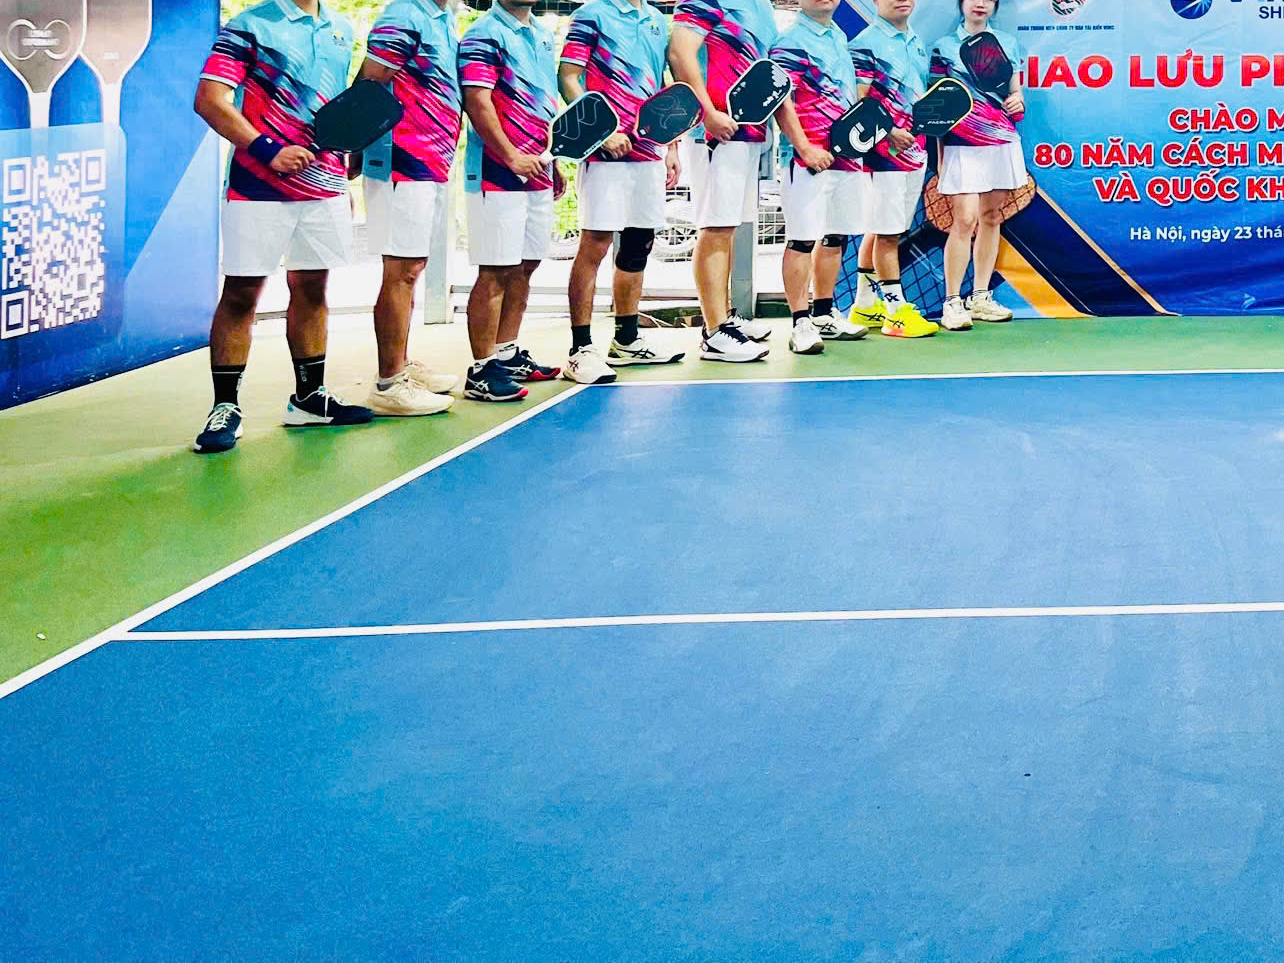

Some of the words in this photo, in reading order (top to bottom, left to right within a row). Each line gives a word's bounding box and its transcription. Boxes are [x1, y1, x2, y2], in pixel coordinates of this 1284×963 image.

[1020, 55, 1114, 88] IAO
[1129, 48, 1225, 88] LƯU
[1168, 102, 1258, 132] CHÀO
[1034, 143, 1073, 168] 80
[1081, 137, 1154, 167] NĂM
[1162, 136, 1249, 167] CÁCH
[1093, 171, 1141, 202] VÀ
[1146, 169, 1240, 207] QUỐC
[1130, 226, 1152, 240] Hà
[1156, 225, 1187, 243] Nội,
[1190, 225, 1231, 243] ngày
[1233, 226, 1253, 240] 23
